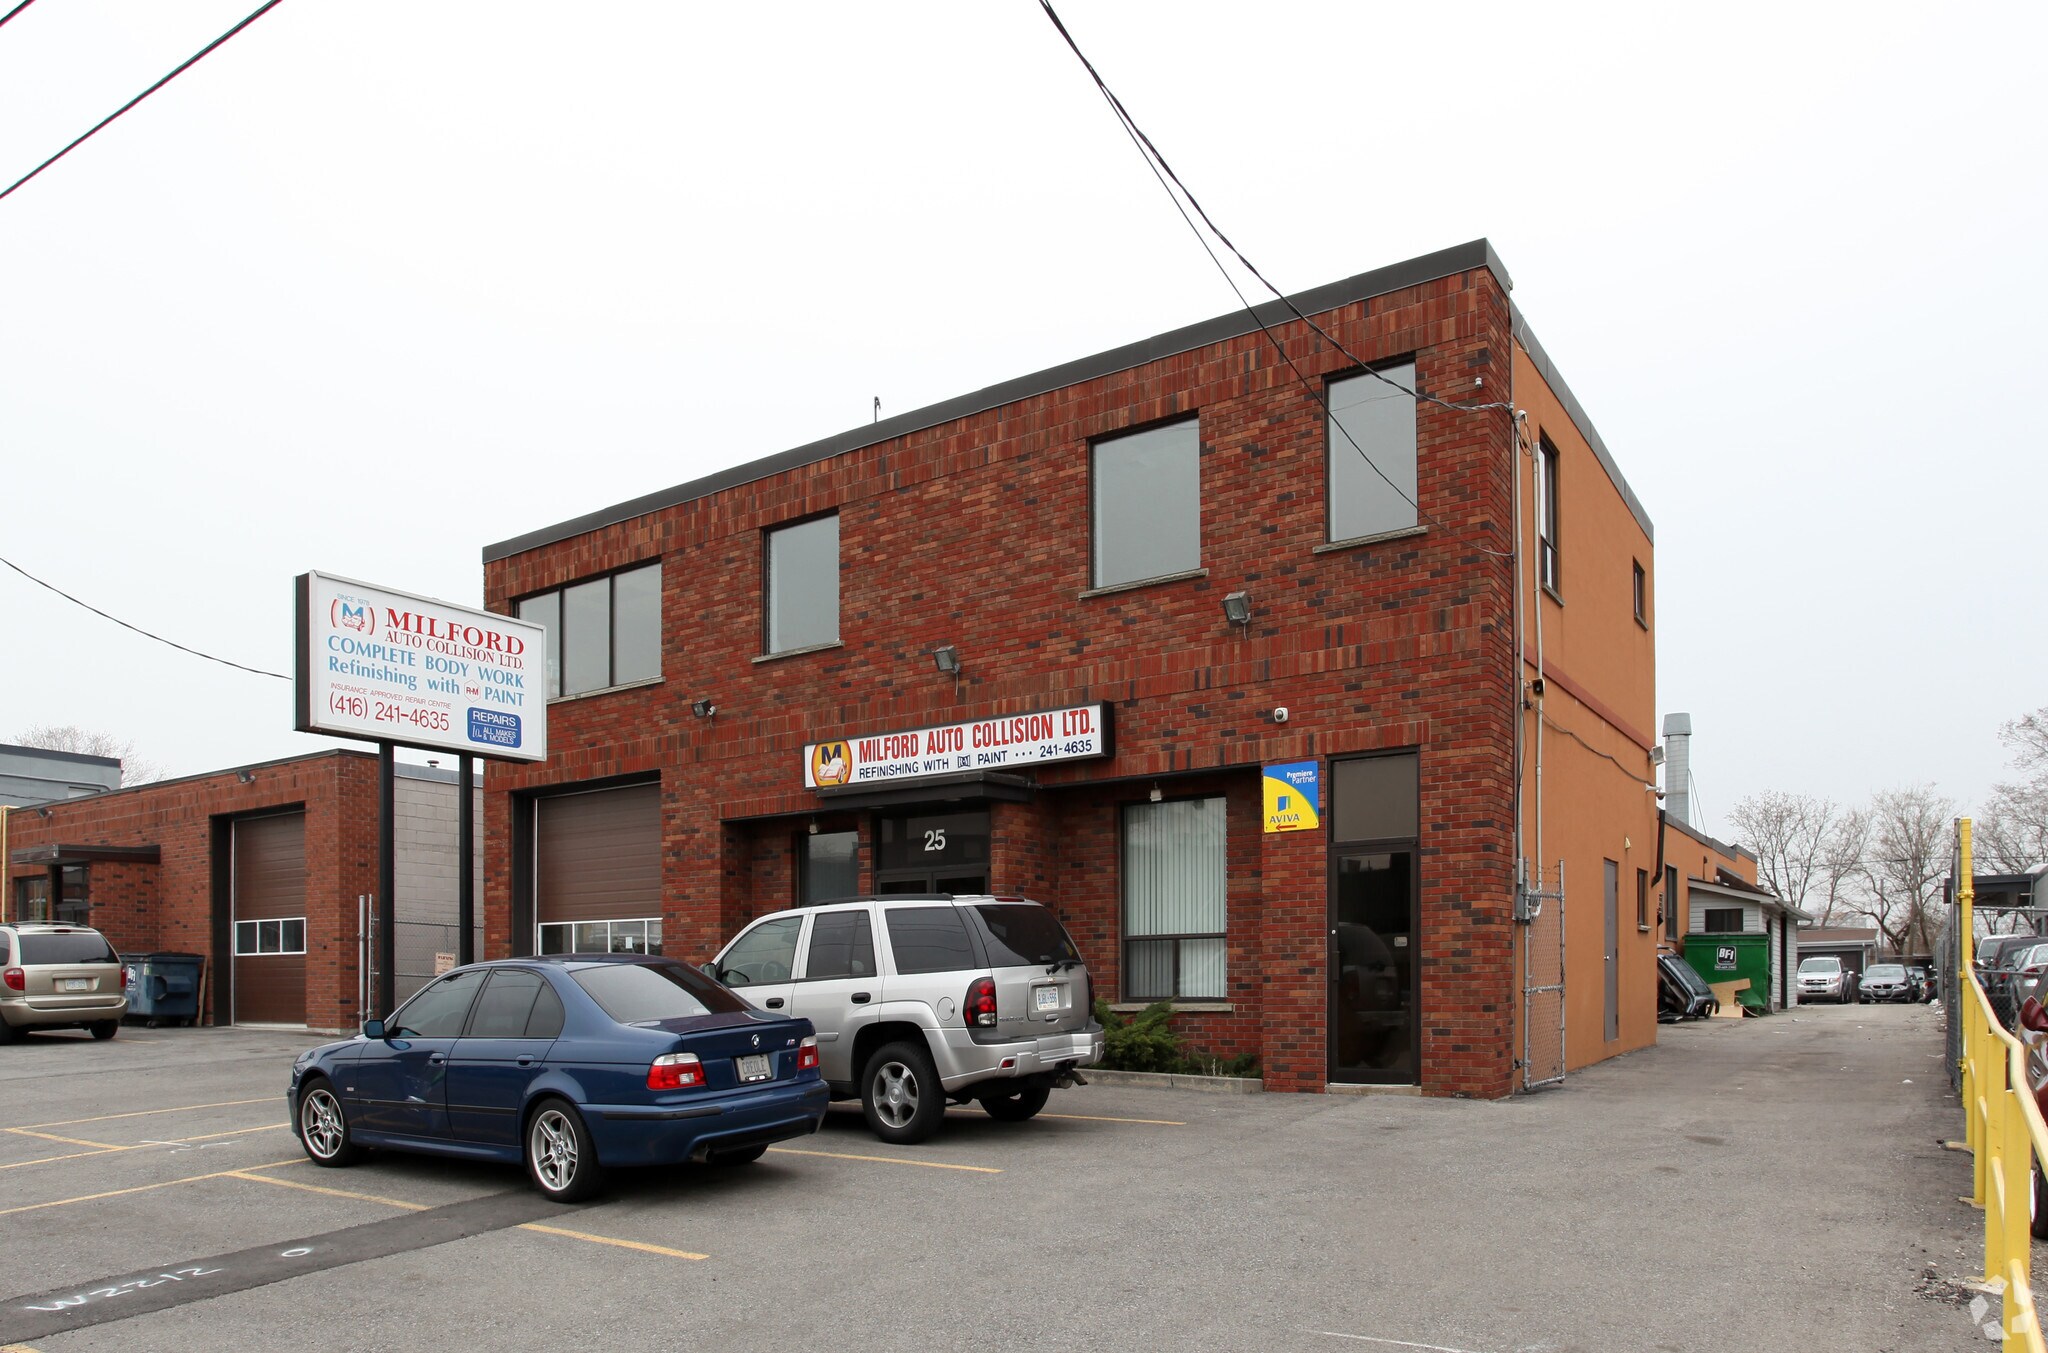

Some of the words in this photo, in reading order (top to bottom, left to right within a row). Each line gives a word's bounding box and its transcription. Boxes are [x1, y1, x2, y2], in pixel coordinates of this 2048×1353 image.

[385, 607, 525, 655] MILFORD
[385, 630, 422, 649] AUTO
[427, 638, 495, 663] COLLISION
[499, 654, 524, 670] LTD.
[328, 635, 416, 667] COMPLETE
[425, 655, 469, 677] BODY
[478, 666, 524, 689] WORK
[329, 655, 418, 691] Refinishing
[427, 677, 460, 695] with
[485, 686, 524, 706] PAINT
[330, 682, 367, 695] INSURANCE
[370, 690, 403, 701] APPROVED
[406, 696, 426, 705] REPAIR
[428, 700, 452, 709] CENTRE
[329, 691, 368, 720] (416)
[375, 702, 450, 731] 241-4635
[472, 710, 516, 727] REPAIRS
[483, 727, 494, 736] ALL
[496, 729, 516, 739] MAKES
[490, 735, 514, 745] MODELS
[859, 733, 919, 764] MILFORD
[926, 727, 964, 755] AUTO
[972, 714, 1053, 748] COLLISION
[1062, 709, 1095, 737] LTD.
[821, 744, 842, 765] M
[859, 762, 919, 779] REFINISHING
[923, 758, 949, 771] WITH
[977, 750, 1008, 765] PAINT
[1039, 740, 1093, 758] 241-4635
[1286, 770, 1313, 778] Premiere
[1291, 776, 1317, 784] Partner
[1269, 813, 1300, 824] AVIVA
[924, 829, 946, 851] 25
[1719, 948, 1734, 960] BFI
[742, 1059, 766, 1075] CREOLE
